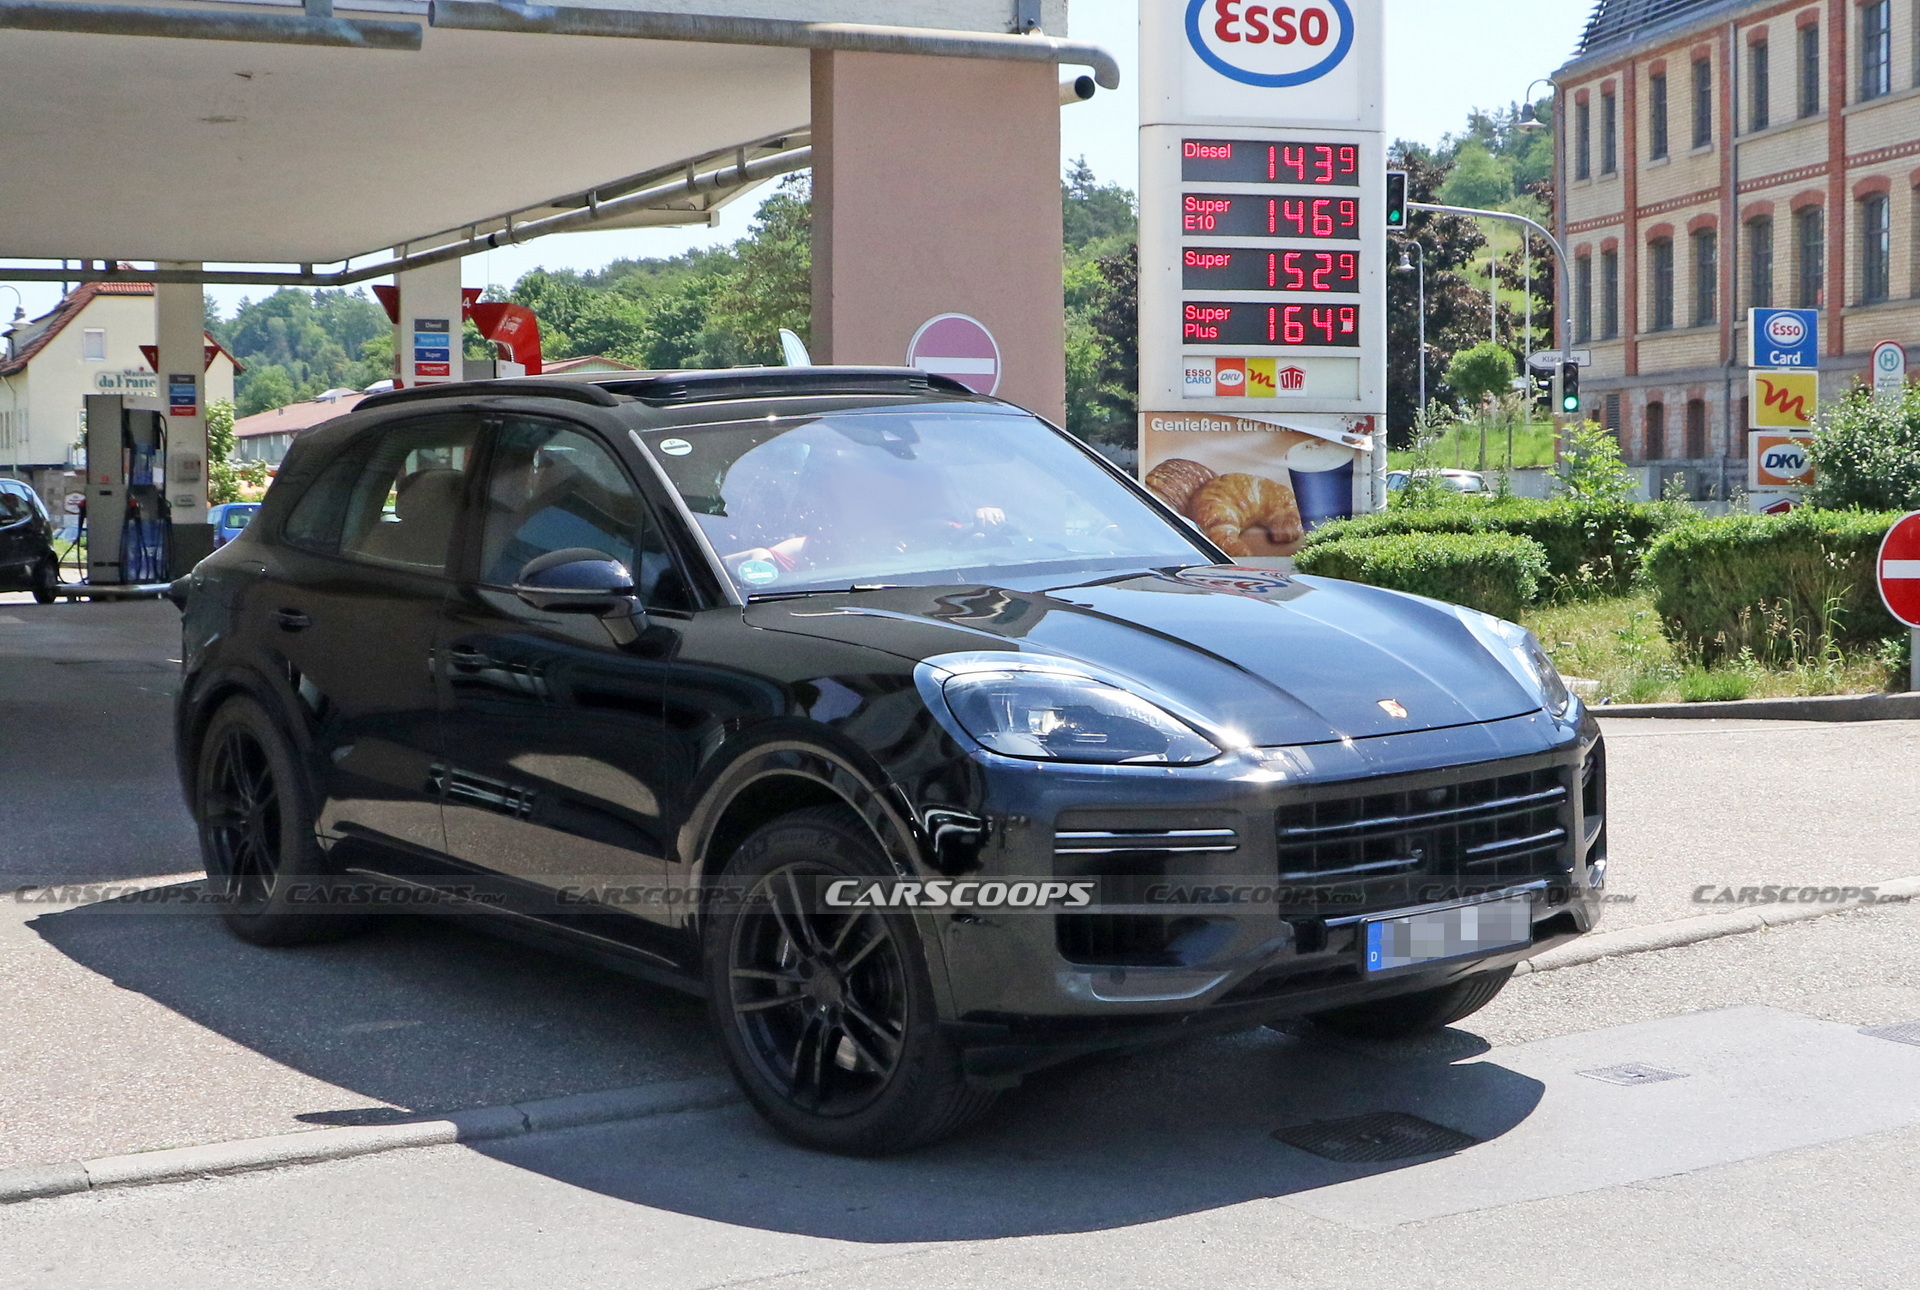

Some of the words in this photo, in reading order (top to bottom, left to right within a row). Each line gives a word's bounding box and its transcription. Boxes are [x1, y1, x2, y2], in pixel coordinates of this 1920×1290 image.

[1184, 142, 1232, 159] Diesel
[1185, 196, 1230, 213] Super
[1185, 215, 1215, 230] E10
[1185, 250, 1230, 267] Super
[462, 297, 471, 308] 4
[1185, 305, 1230, 321] Super
[1185, 323, 1218, 339] Plus
[1772, 322, 1801, 336] Esso
[1769, 350, 1801, 365] Card
[1185, 369, 1212, 377] ESSO
[1185, 376, 1212, 384] CARD
[1220, 373, 1240, 381] DKV
[1280, 367, 1304, 389] UTA
[99, 376, 113, 388] da
[1151, 417, 1231, 432] Genießen
[1237, 418, 1258, 432] für
[1765, 453, 1805, 469] DKV
[1371, 951, 1378, 963] D
